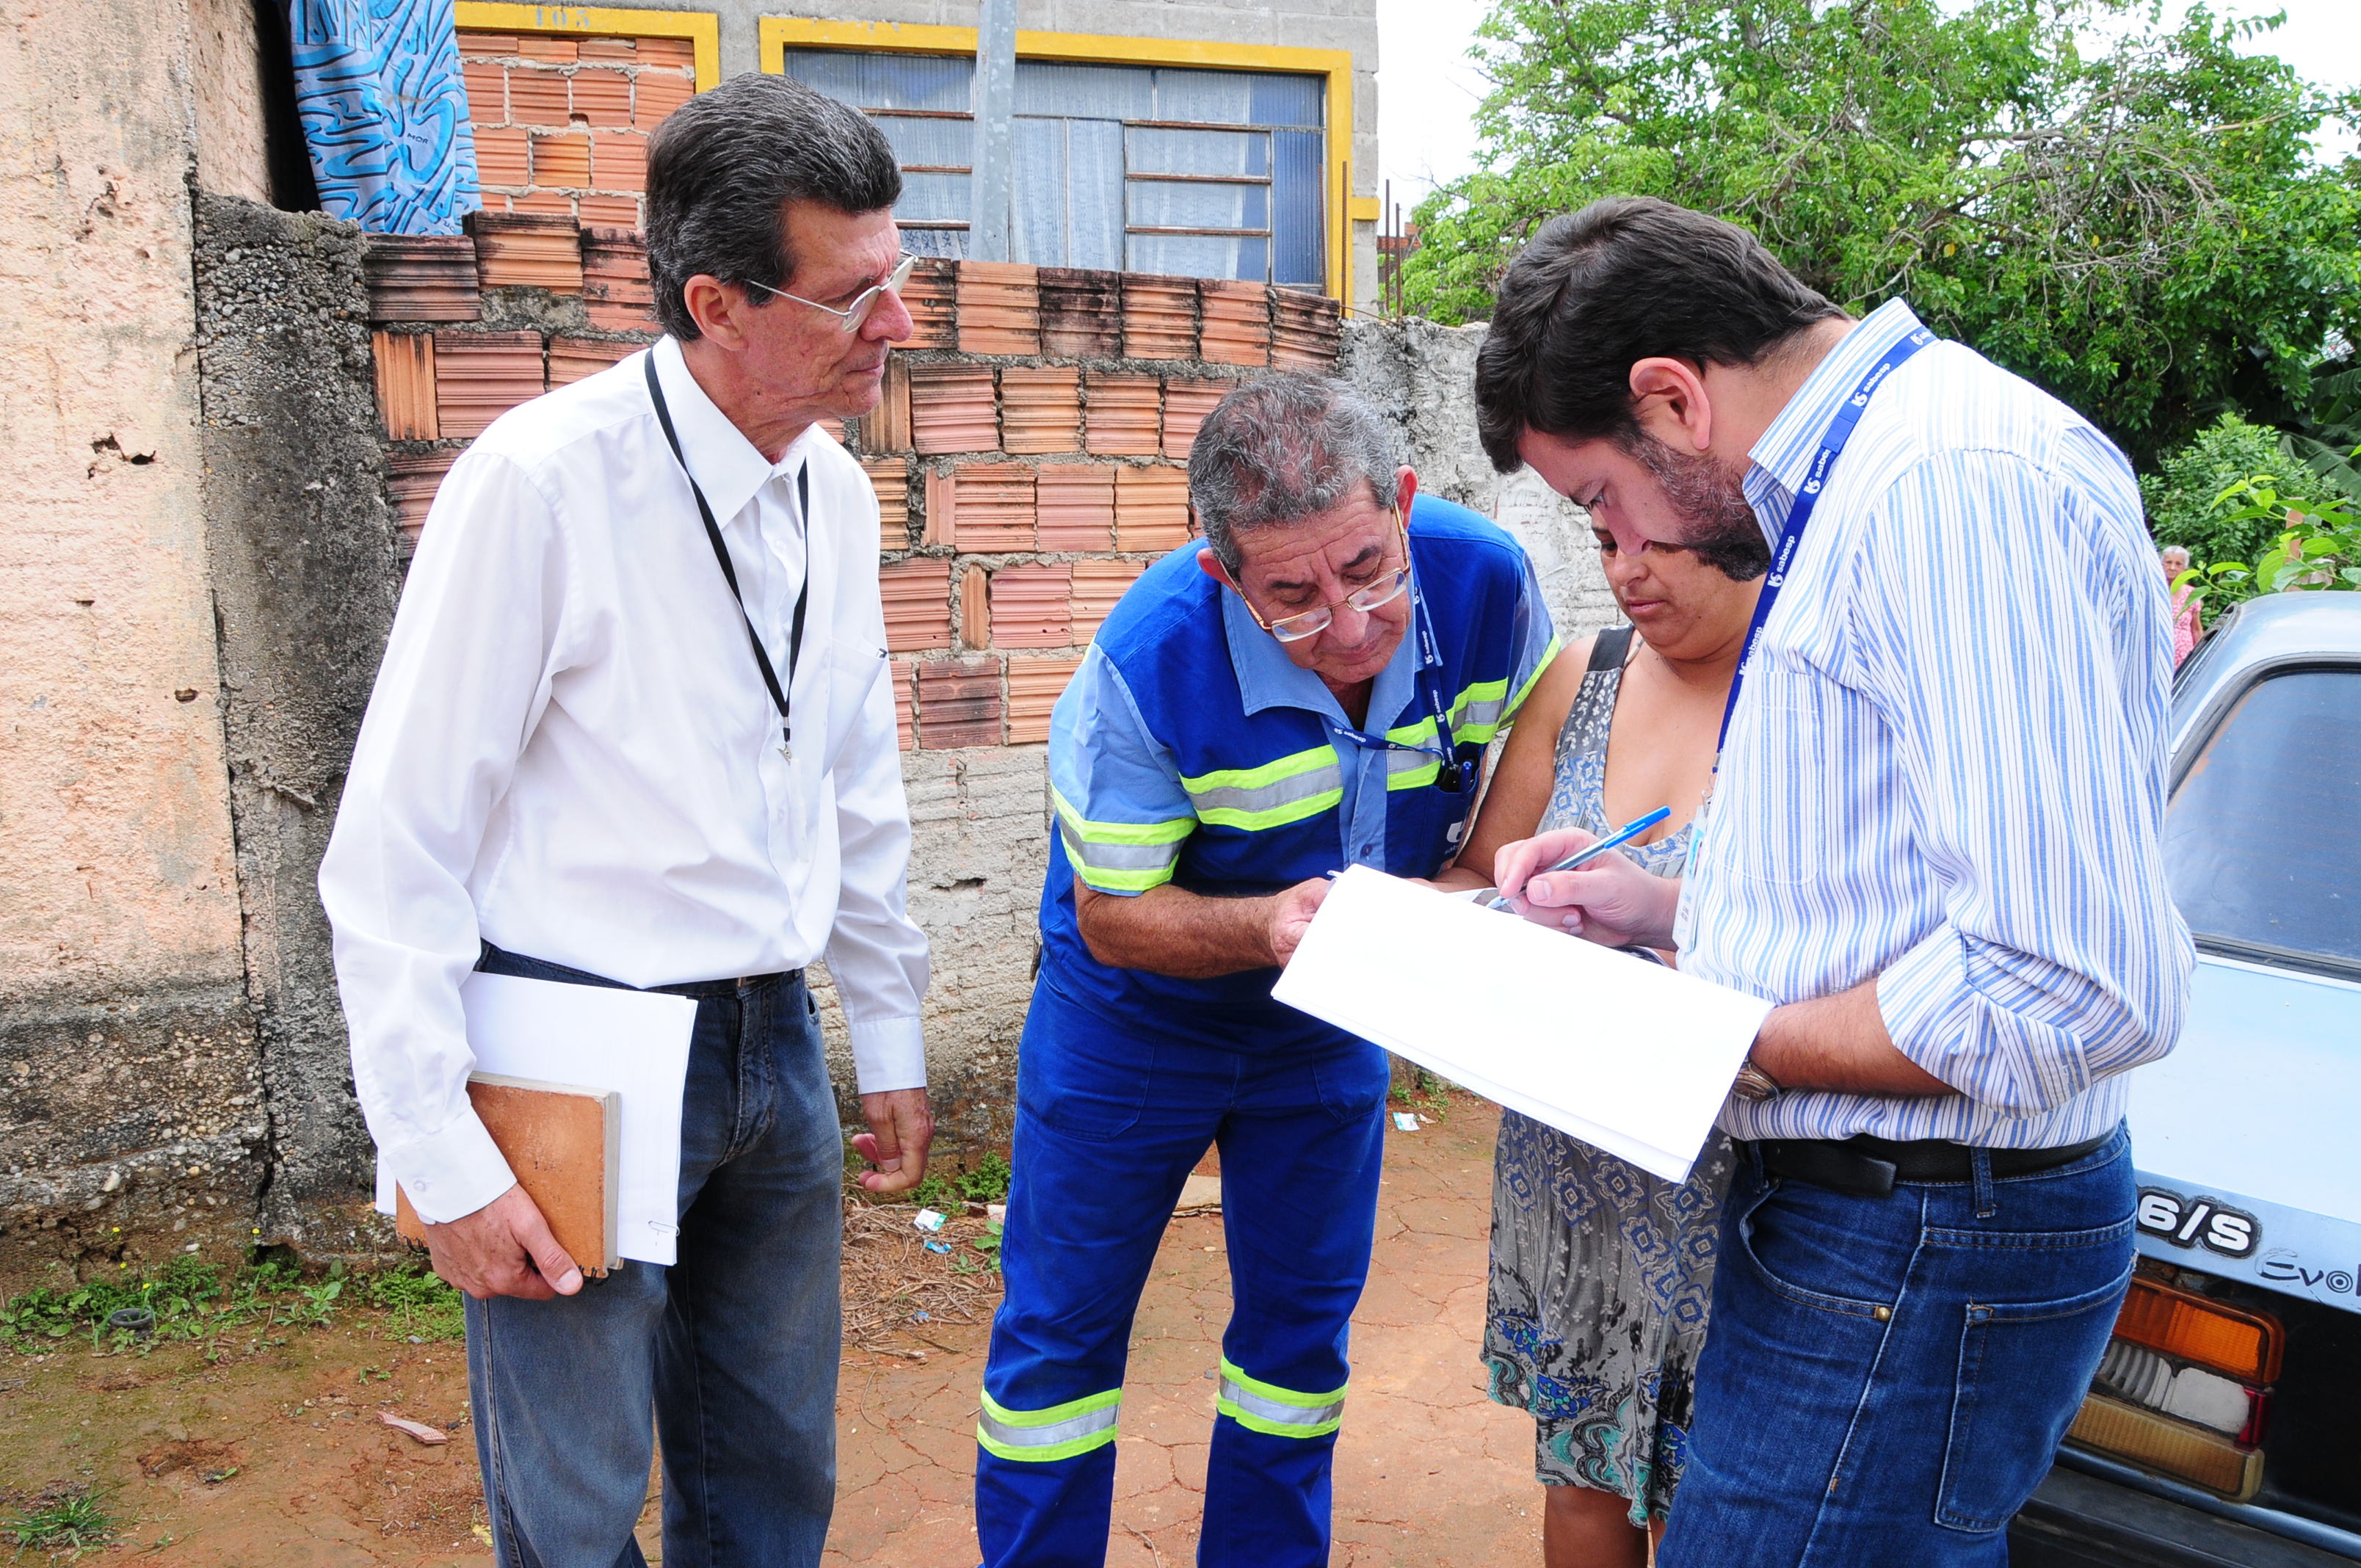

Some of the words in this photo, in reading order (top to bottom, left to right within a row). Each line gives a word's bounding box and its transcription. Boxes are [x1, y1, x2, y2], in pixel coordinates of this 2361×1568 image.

[1863, 363, 1891, 393] sabesp
[1777, 535, 1796, 573] sabesp
[1422, 631, 1430, 654] sabesp
[1433, 690, 1441, 713] sabesp
[1343, 731, 1366, 742] sabesp
